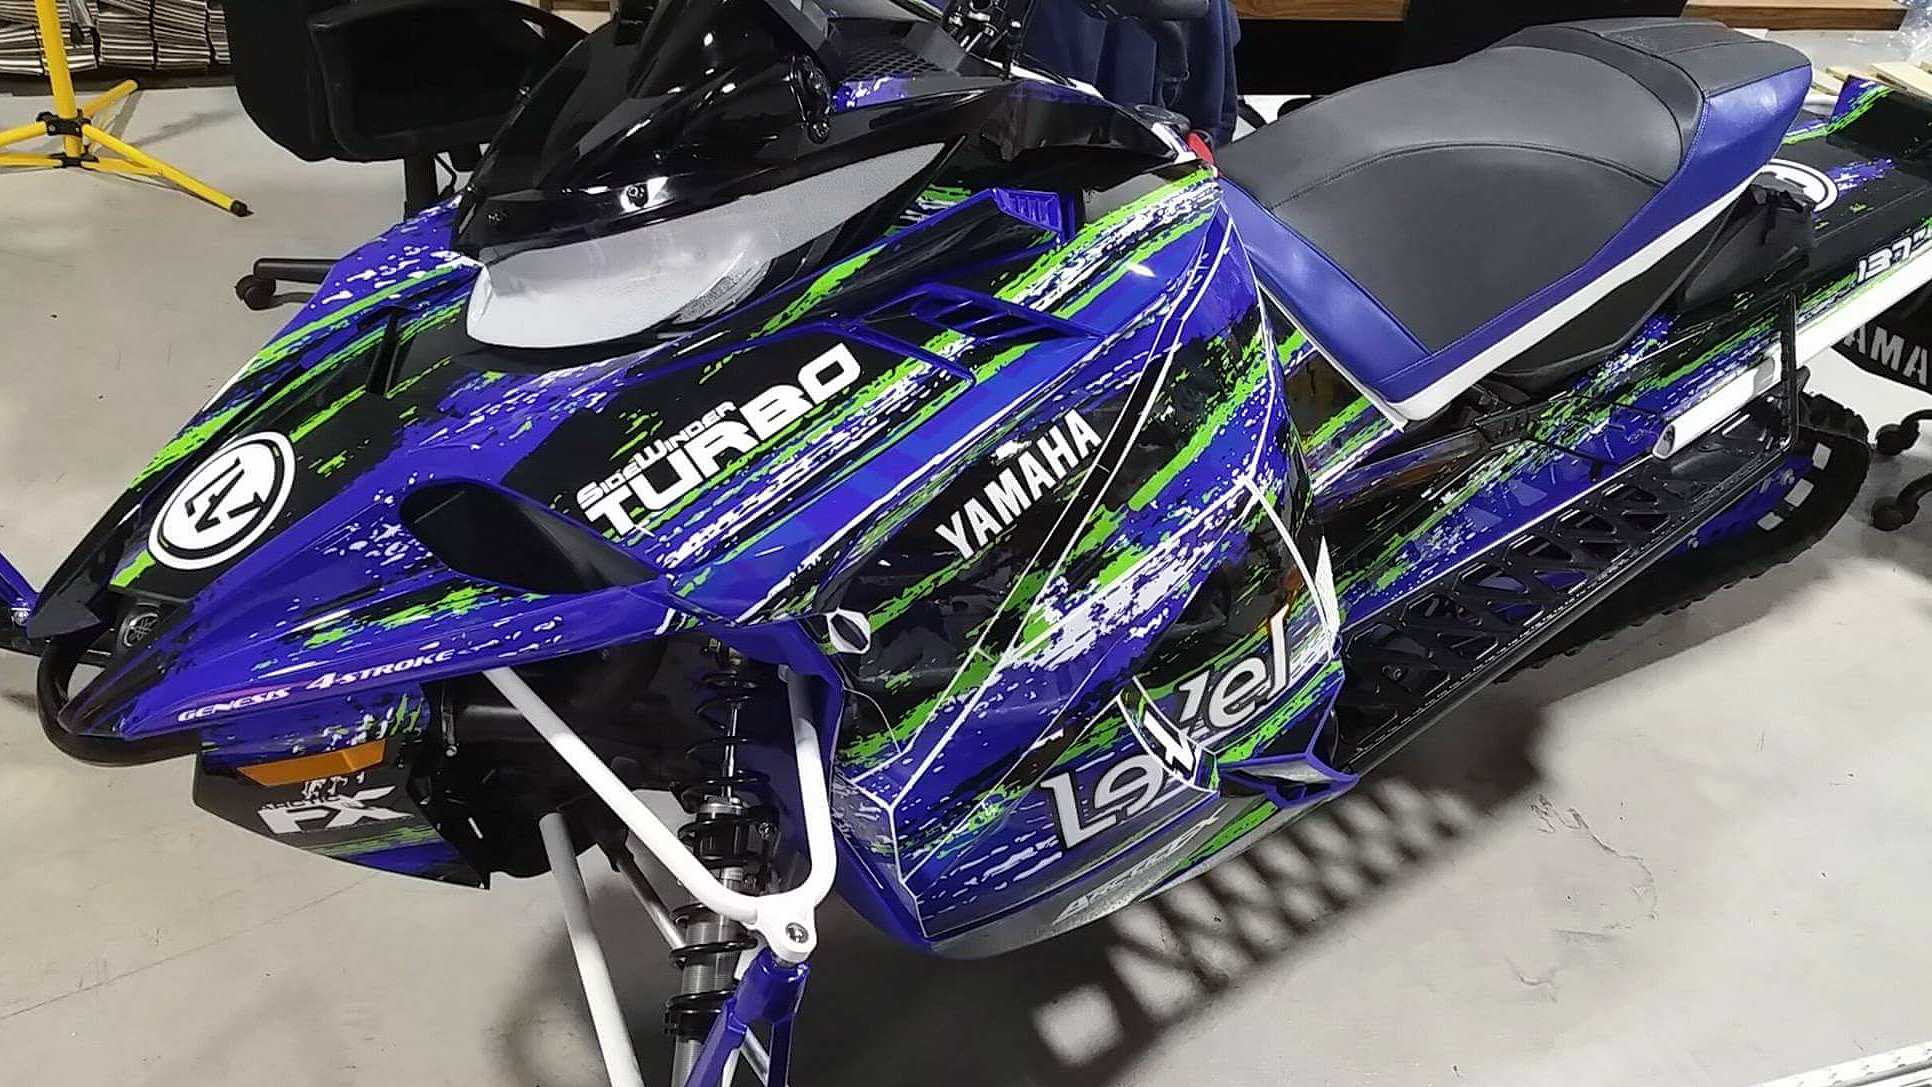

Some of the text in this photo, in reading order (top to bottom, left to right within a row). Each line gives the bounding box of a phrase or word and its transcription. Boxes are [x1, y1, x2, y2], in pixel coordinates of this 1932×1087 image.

[583, 342, 861, 537] TURBO
[934, 408, 1102, 560] YAMAHA
[177, 687, 292, 722] GENESIS
[257, 785, 416, 834] FX
